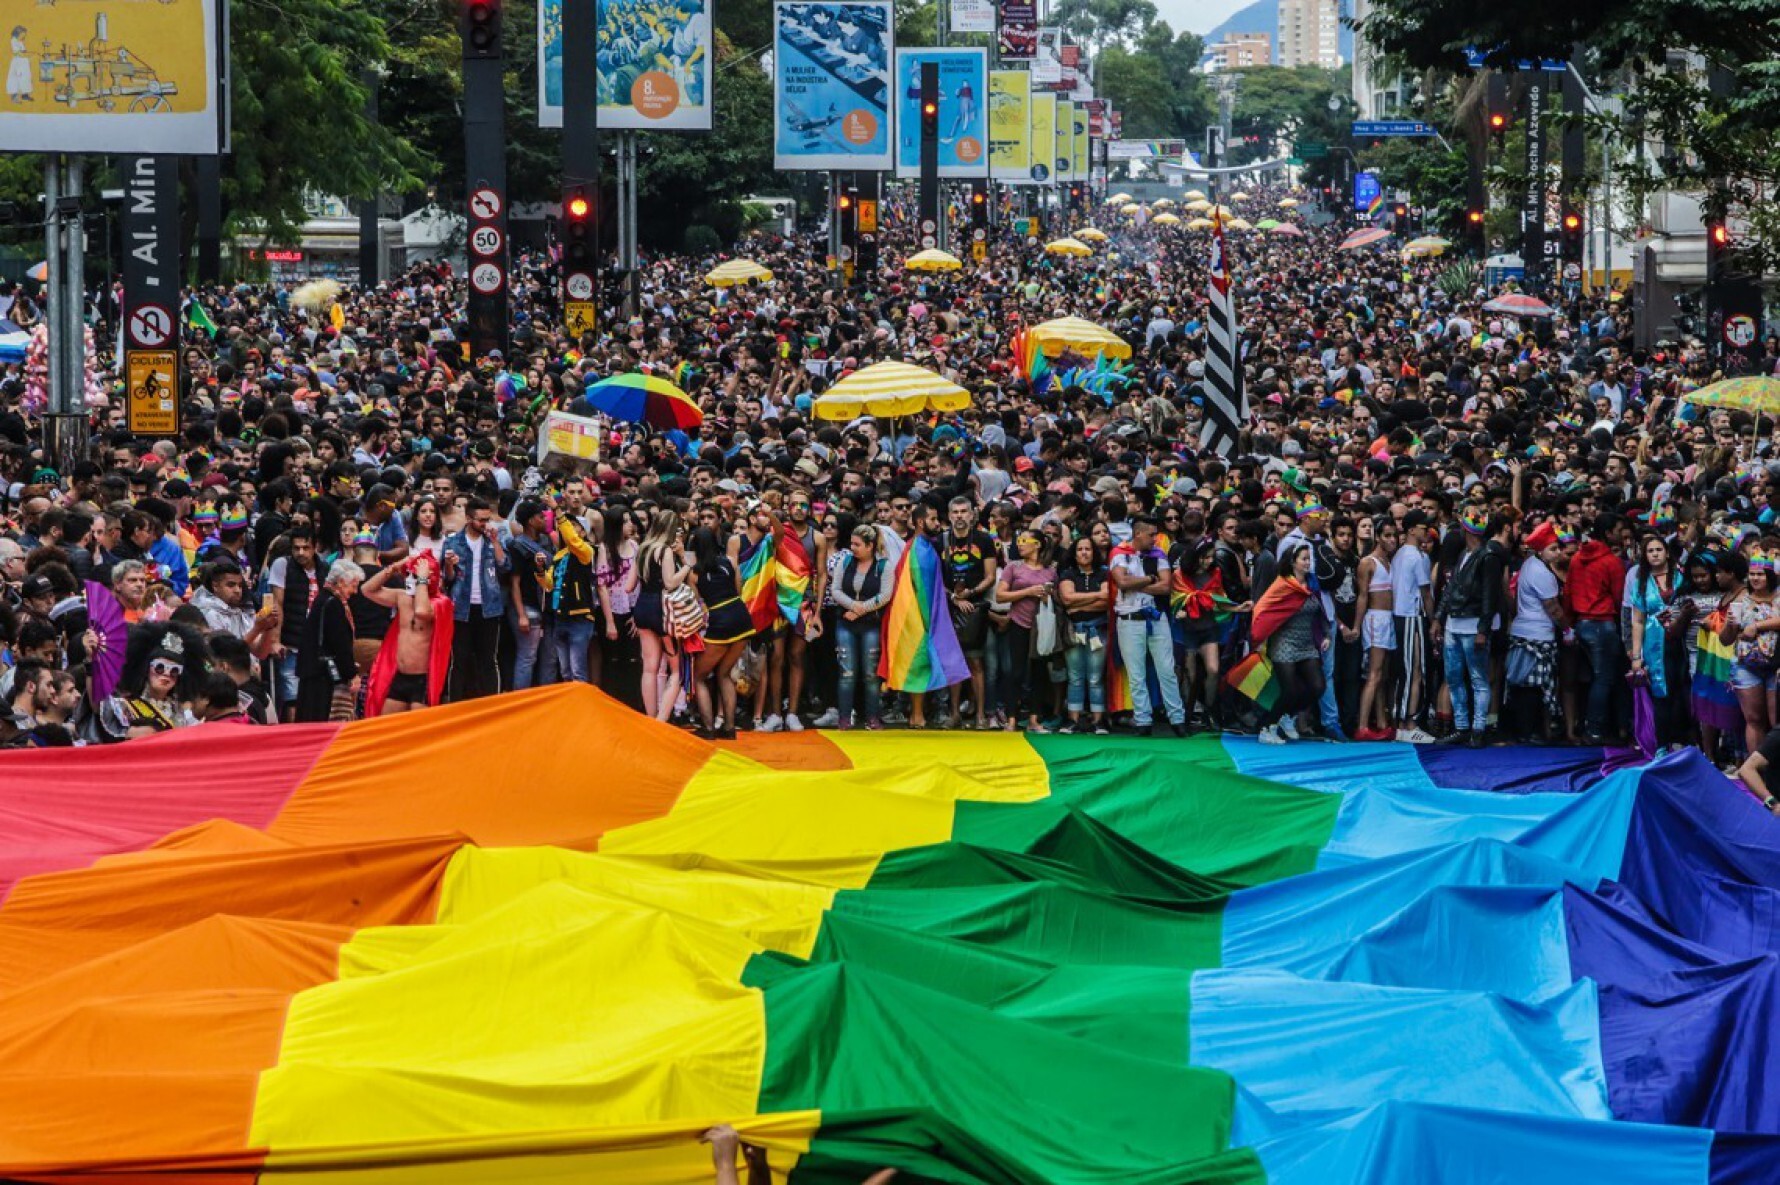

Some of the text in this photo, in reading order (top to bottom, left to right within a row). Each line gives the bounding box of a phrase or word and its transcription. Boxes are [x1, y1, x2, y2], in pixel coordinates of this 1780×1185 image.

[792, 66, 816, 74] MULHER
[786, 76, 797, 84] NA
[1528, 85, 1539, 138] Azevedo
[131, 157, 158, 266] Al. Min
[476, 231, 497, 247] 50
[1543, 240, 1559, 255] 51
[131, 357, 173, 365] CICLISTA
